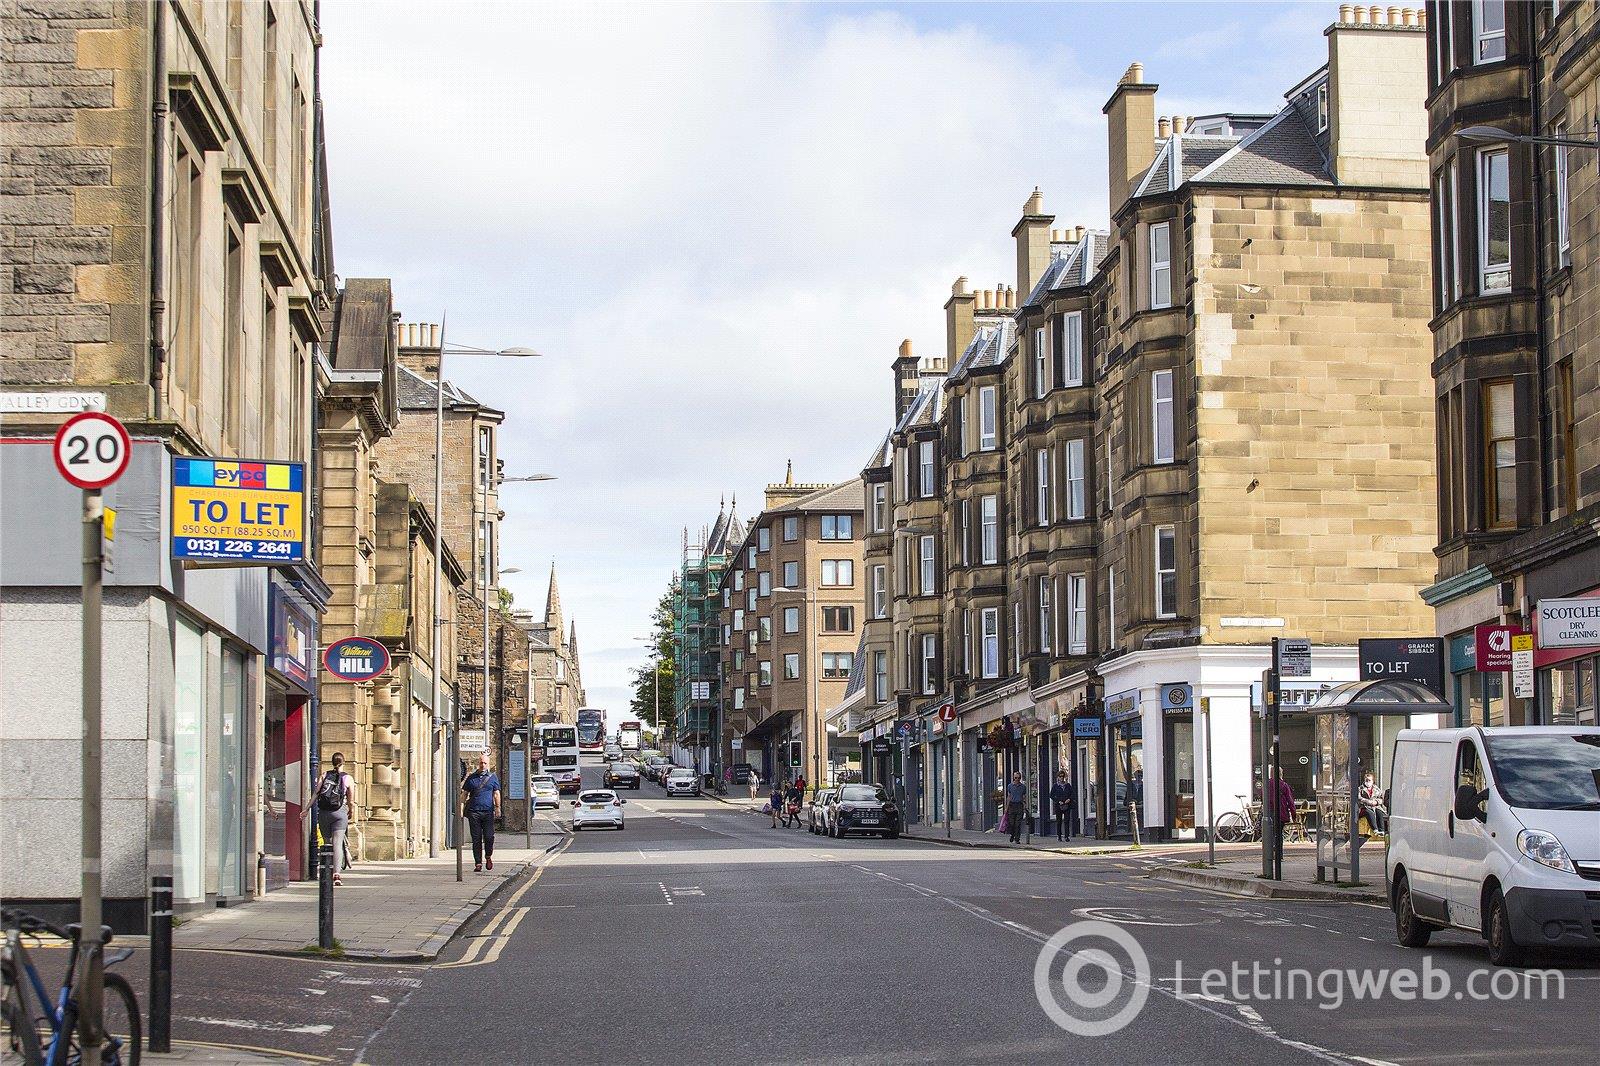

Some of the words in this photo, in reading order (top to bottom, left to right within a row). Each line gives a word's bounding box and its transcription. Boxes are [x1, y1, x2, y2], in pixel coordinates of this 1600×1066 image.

[0, 396, 51, 408] ALLEY
[67, 434, 119, 464] 20
[214, 467, 265, 482] eyco
[188, 499, 229, 523] TO
[240, 501, 290, 526] LET
[182, 524, 200, 534] 950
[203, 525, 231, 536] SQ.FT
[234, 526, 264, 537] (88.25
[266, 528, 296, 538] SQ.M)
[186, 539, 220, 551] 0131
[224, 540, 253, 552] 226
[257, 541, 291, 554] 2641
[1569, 621, 1586, 630] DRY
[1559, 630, 1598, 640] CLEANING
[339, 658, 374, 673] HILL
[1366, 662, 1384, 673] TO
[1388, 661, 1410, 673] LET
[1075, 726, 1100, 734] NERO
